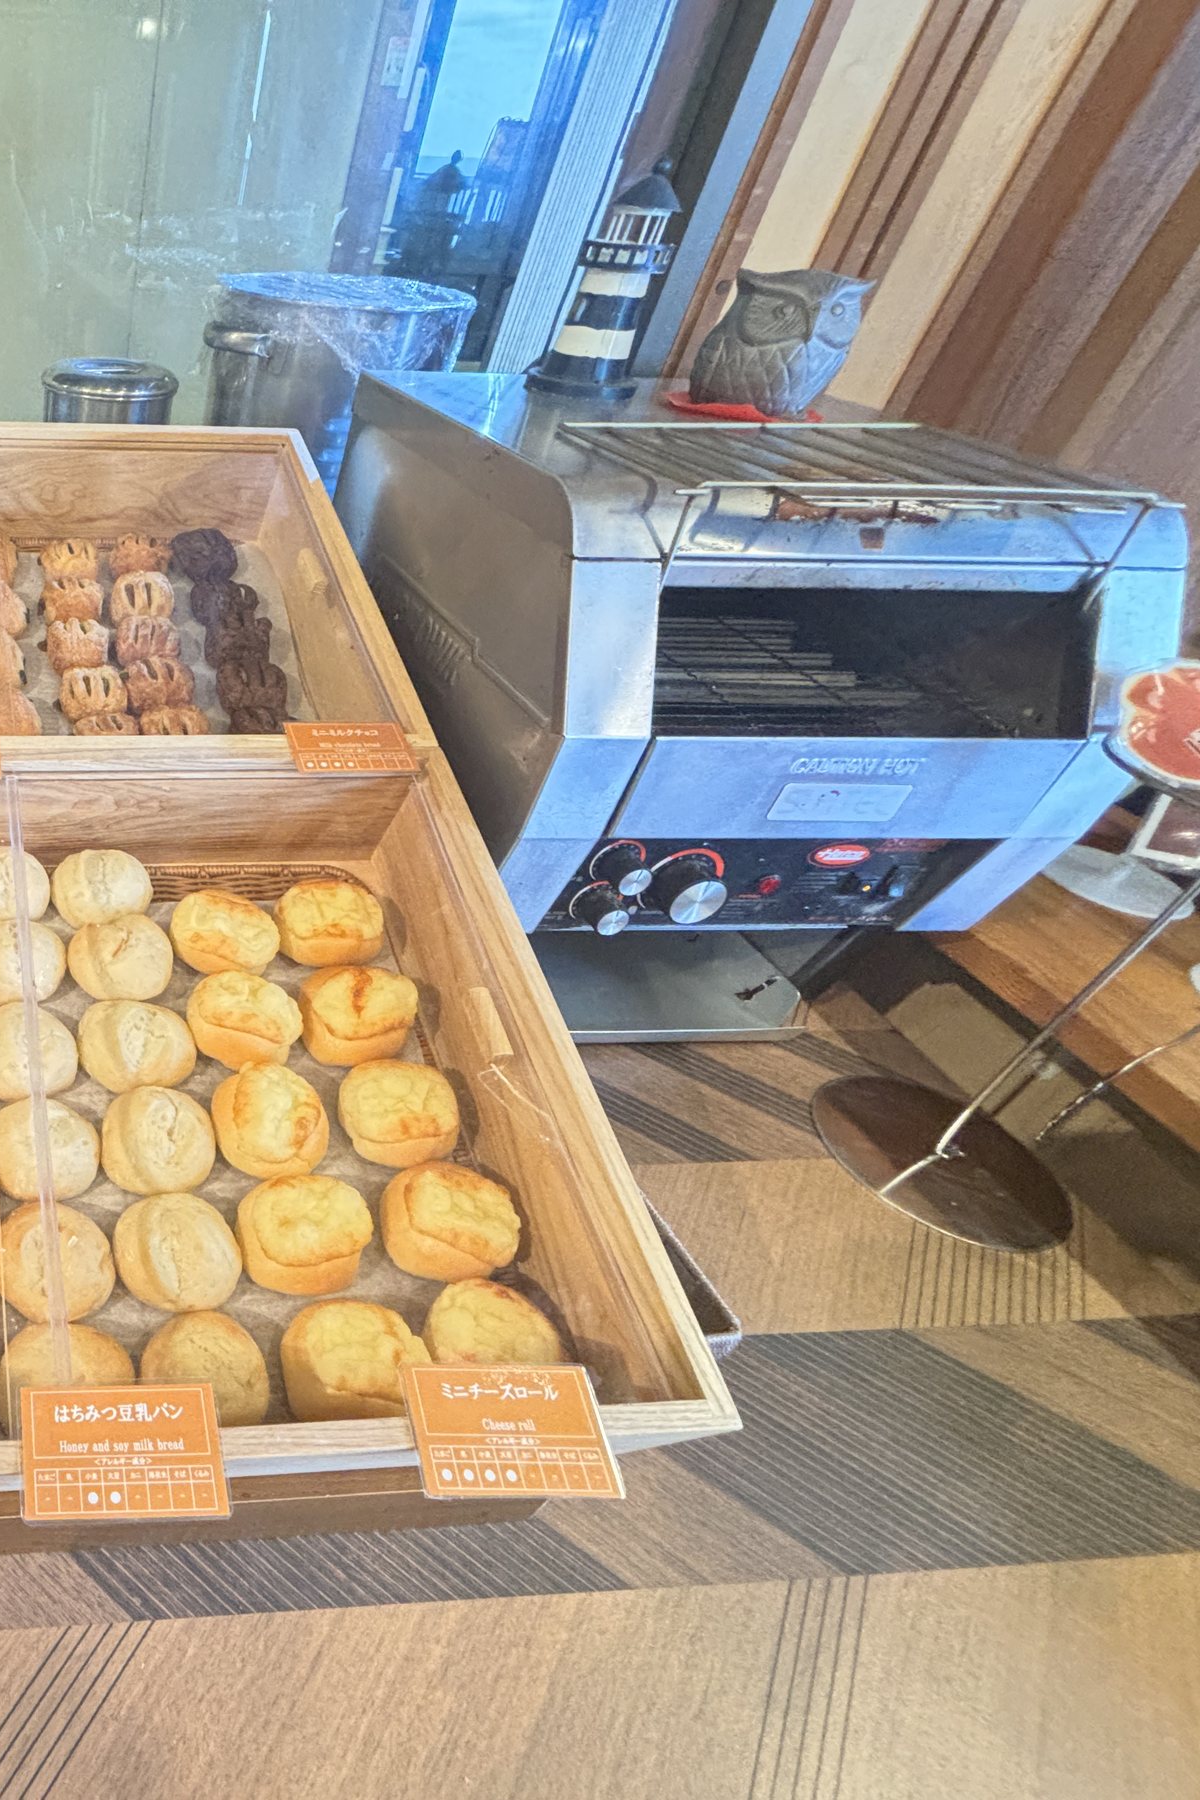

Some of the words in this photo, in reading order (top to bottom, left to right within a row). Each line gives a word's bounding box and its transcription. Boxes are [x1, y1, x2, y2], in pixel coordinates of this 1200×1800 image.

[878, 757, 928, 776] HOT
[441, 1382, 559, 1400] ミニチーズロール
[54, 1402, 184, 1423] はちみつ豆乳パン
[482, 1417, 517, 1431] Cheese
[518, 1418, 537, 1431] roll
[59, 1439, 89, 1454] Honey
[92, 1439, 110, 1452] and
[113, 1441, 130, 1454] soy
[132, 1438, 155, 1452] milk
[157, 1437, 185, 1451] bread
